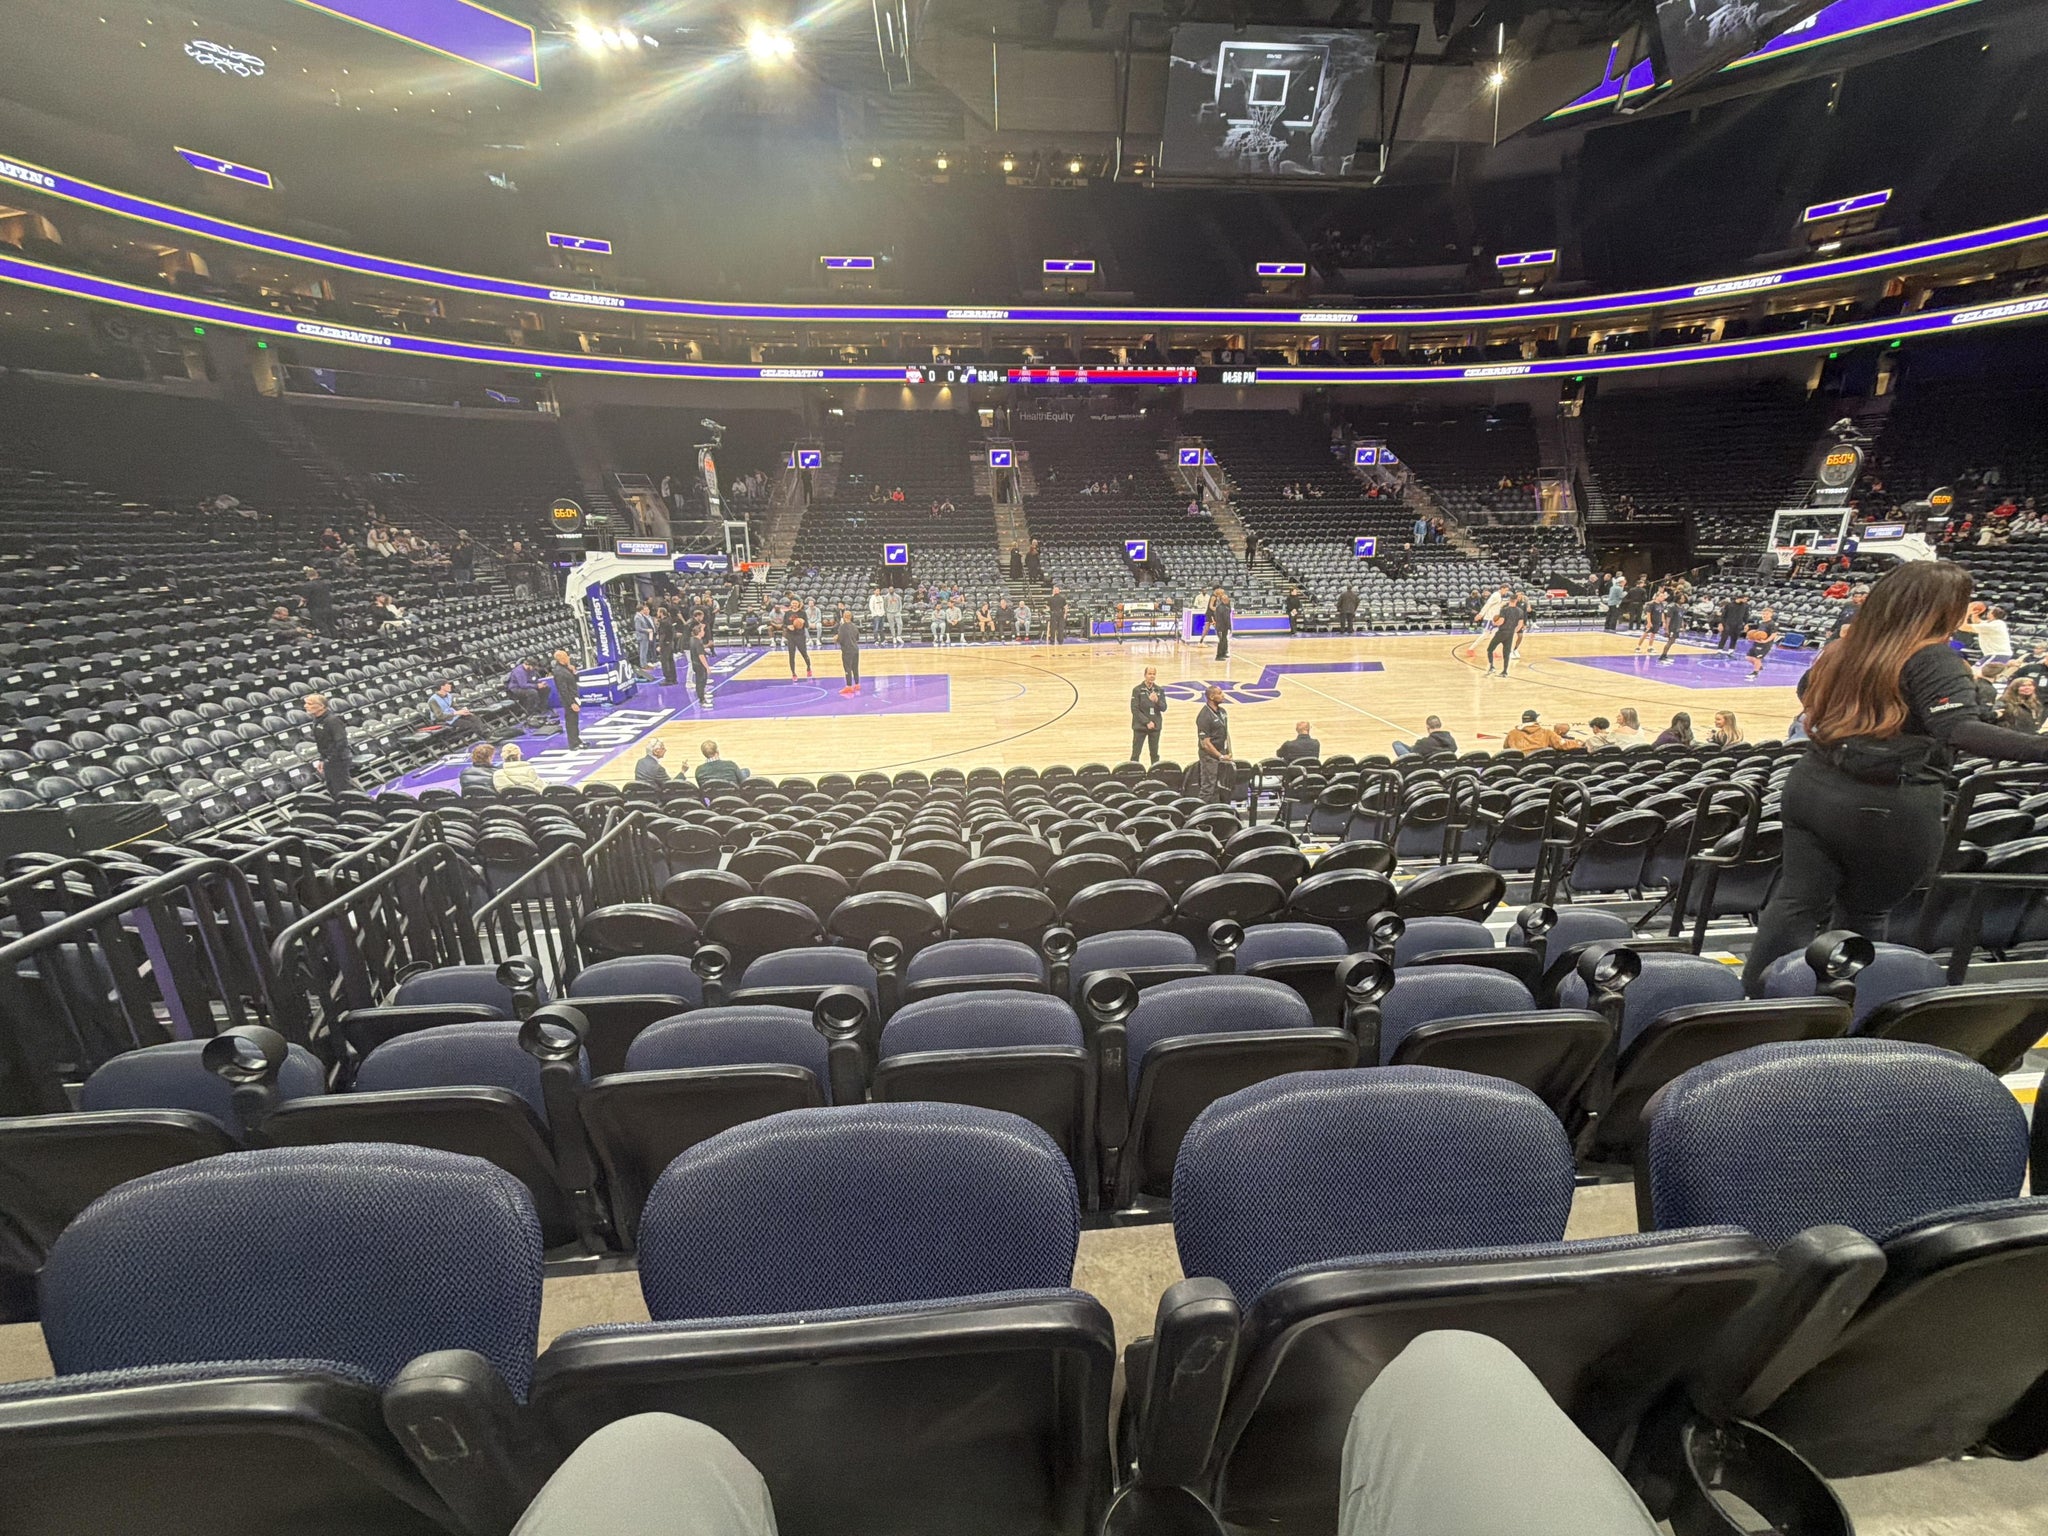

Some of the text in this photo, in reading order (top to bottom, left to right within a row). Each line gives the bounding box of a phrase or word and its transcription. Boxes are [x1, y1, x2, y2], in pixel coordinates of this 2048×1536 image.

[1694, 275, 1782, 296] CELEBRATING
[549, 291, 625, 306] CELEBRATING
[296, 323, 391, 345] CELEBRATING
[1019, 411, 1074, 423] HealthEquity
[1826, 453, 1856, 466] 66:04
[554, 508, 577, 518] 66:04
[592, 597, 610, 657] AMERICA FIRST
[578, 708, 677, 746] JAZZ
